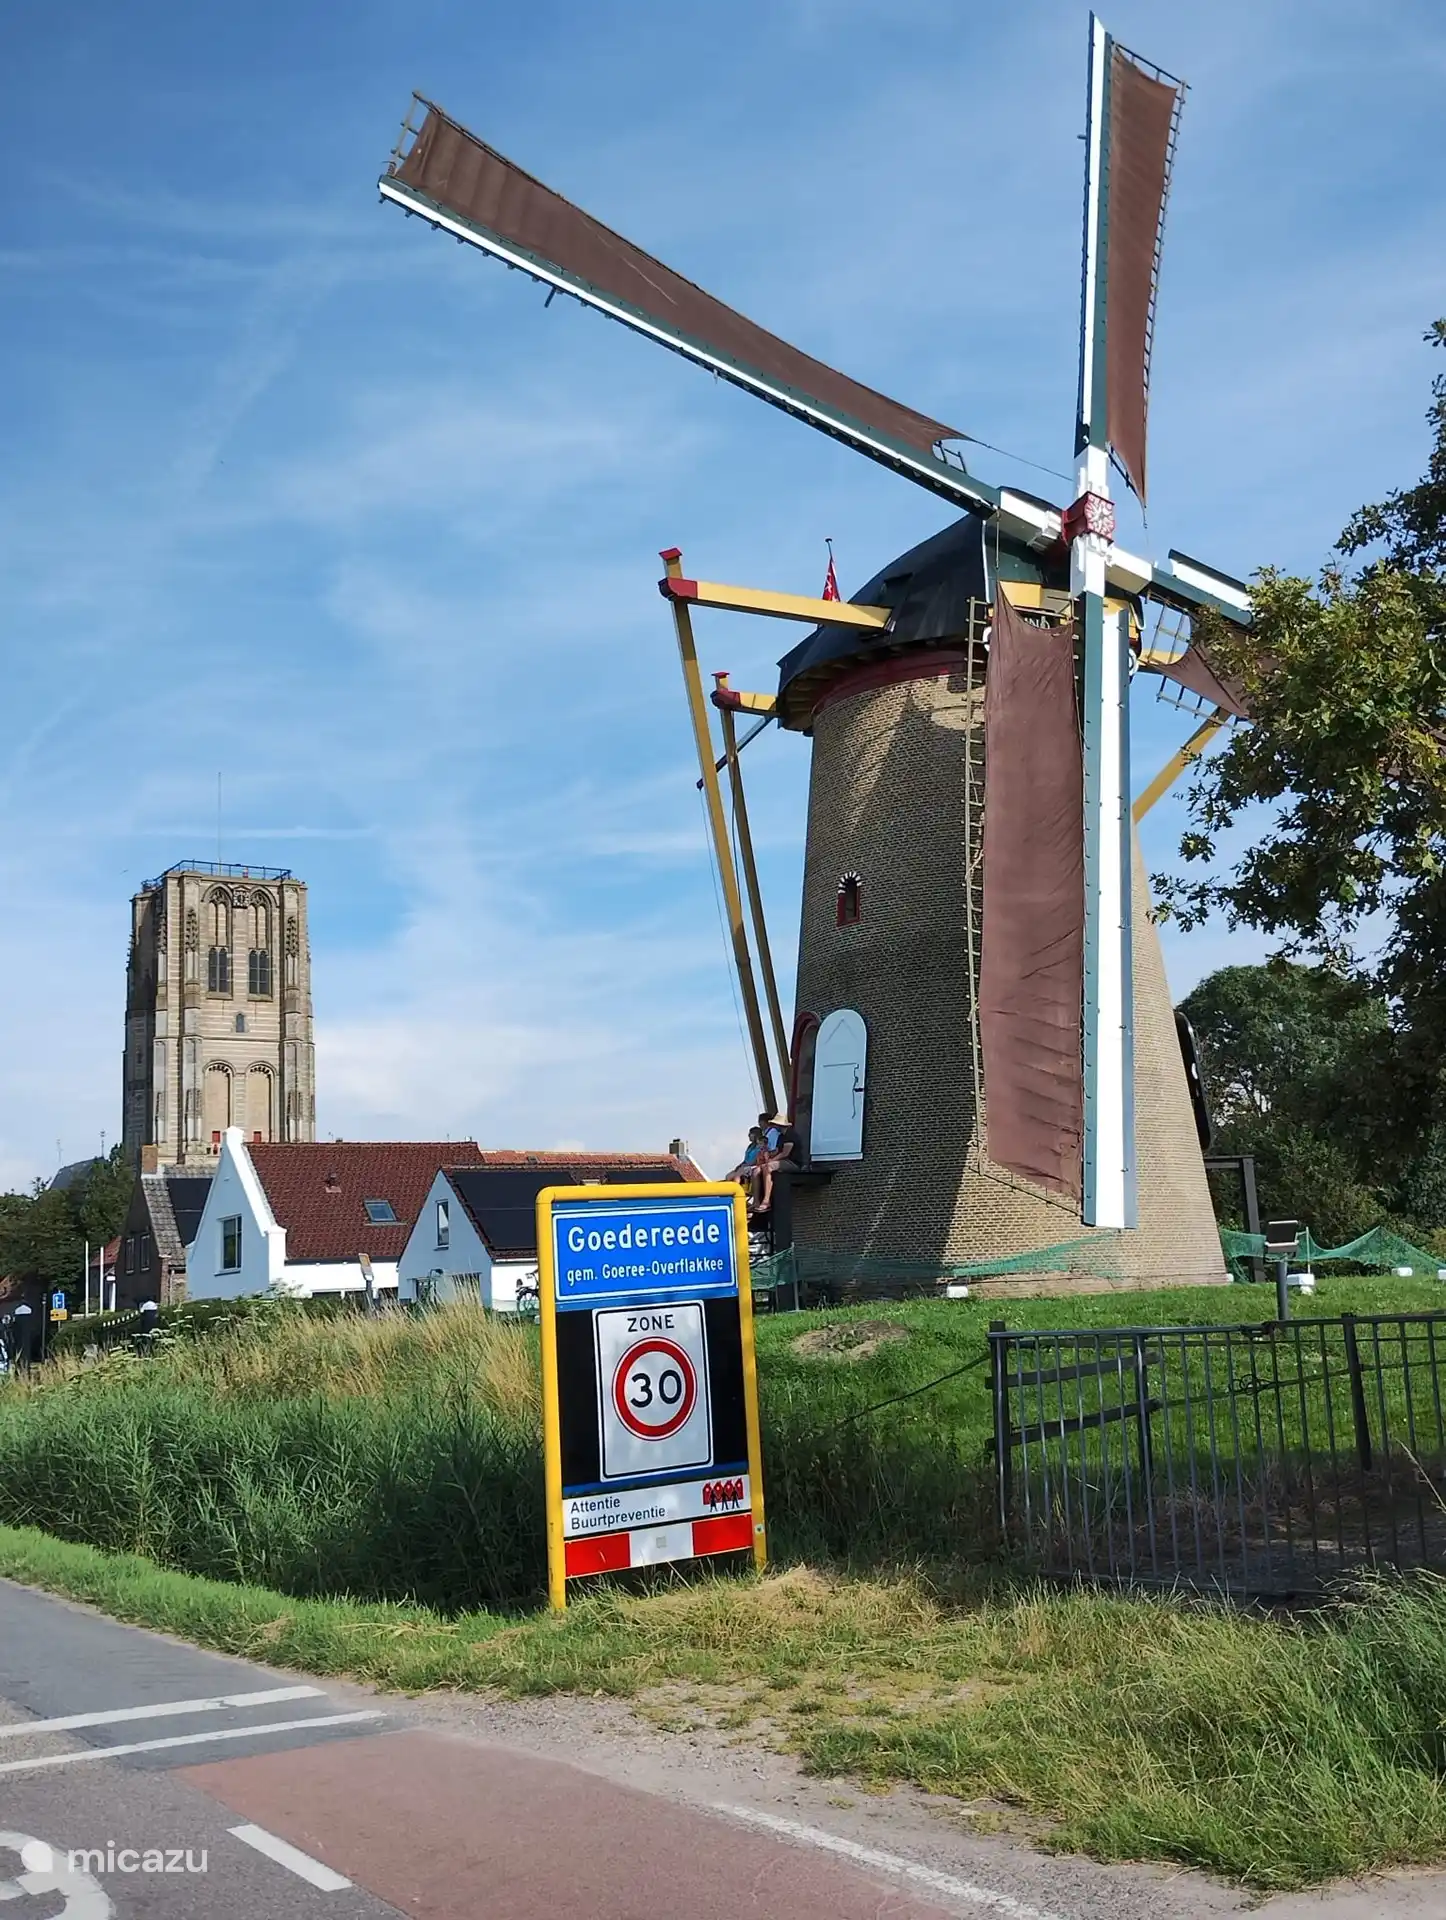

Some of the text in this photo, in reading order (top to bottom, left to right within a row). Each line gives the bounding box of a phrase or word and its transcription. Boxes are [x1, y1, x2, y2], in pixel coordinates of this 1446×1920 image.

[567, 1218, 721, 1252] Goedereede
[567, 1257, 724, 1286] gem. Goeree-Overflakkee
[627, 1314, 675, 1333] ZONE
[630, 1369, 682, 1408] 30
[570, 1497, 621, 1514] Attentie
[571, 1505, 666, 1530] Buurtpreventie
